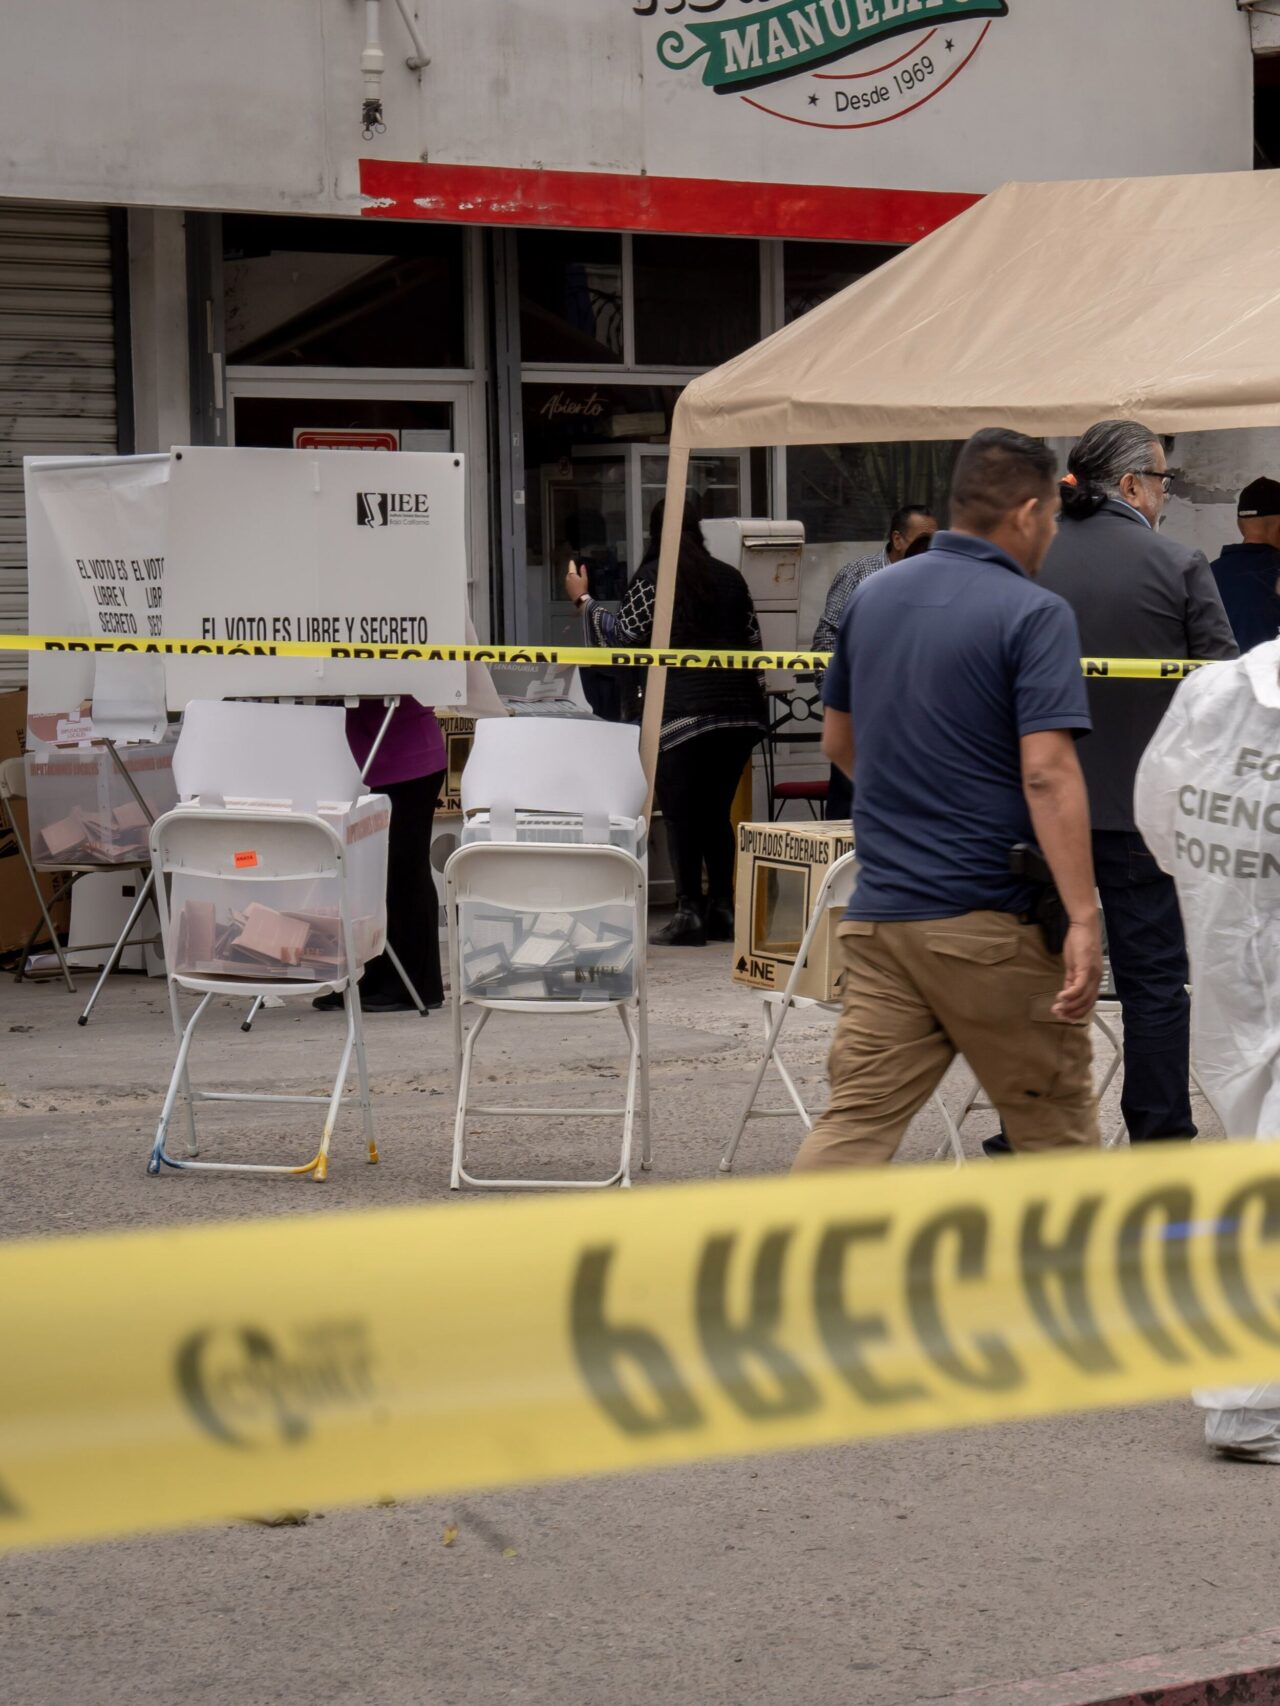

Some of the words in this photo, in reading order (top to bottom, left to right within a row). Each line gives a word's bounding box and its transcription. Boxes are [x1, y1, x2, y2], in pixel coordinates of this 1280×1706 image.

[834, 86, 890, 112] Desde
[893, 55, 935, 95] 1969
[540, 391, 608, 419] Abierto
[390, 493, 430, 513] IEE
[76, 559, 91, 579] EL
[88, 559, 116, 580] VOTO
[114, 559, 129, 580] ES
[131, 560, 145, 581] EL
[93, 585, 121, 607] LIBRE
[118, 586, 128, 607] Y
[98, 611, 138, 635] SECRETO
[225, 617, 267, 641] VOTO
[272, 617, 292, 642] ES
[297, 617, 340, 643] LIBRE
[344, 617, 355, 643] Y
[360, 616, 428, 645] SECRETO
[740, 825, 783, 858] DIPUTADOS
[784, 832, 829, 865] FEDERALES
[750, 959, 775, 982] INE
